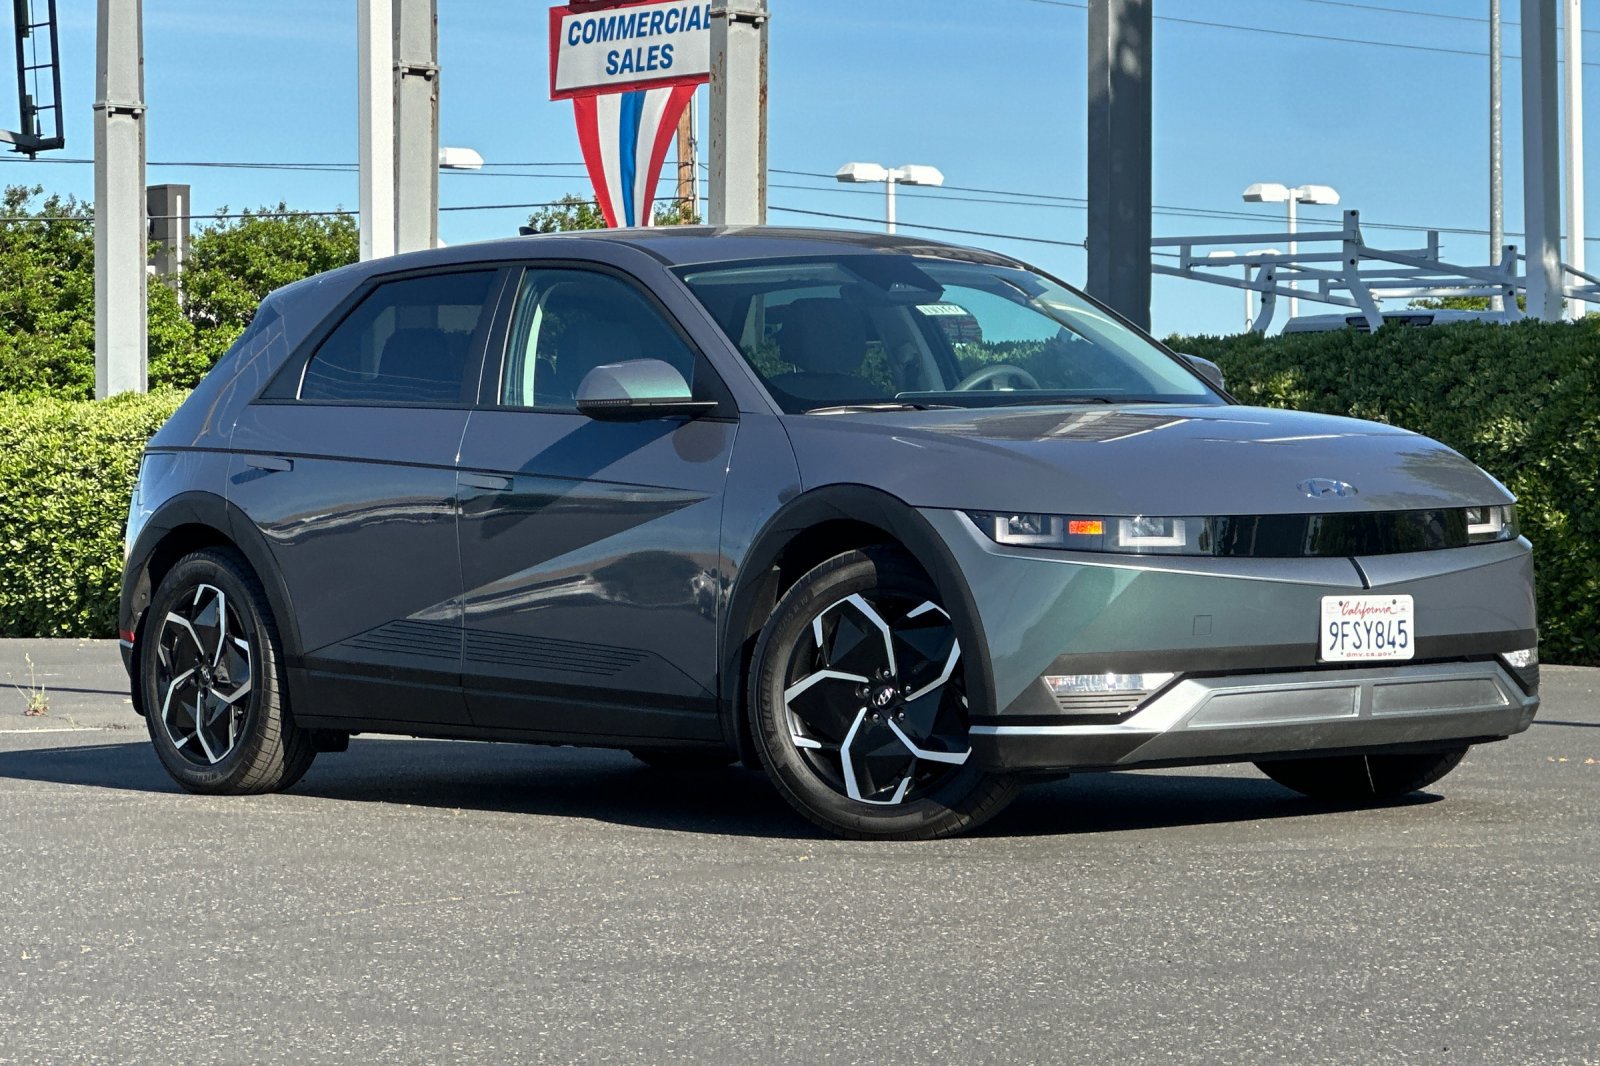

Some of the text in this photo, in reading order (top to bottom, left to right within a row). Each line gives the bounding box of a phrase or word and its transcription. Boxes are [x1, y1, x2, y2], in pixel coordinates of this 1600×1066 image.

[568, 4, 711, 46] COMMERCIAL
[605, 43, 674, 76] SALES
[1341, 601, 1397, 619] California
[1329, 620, 1408, 651] 9FSY845
